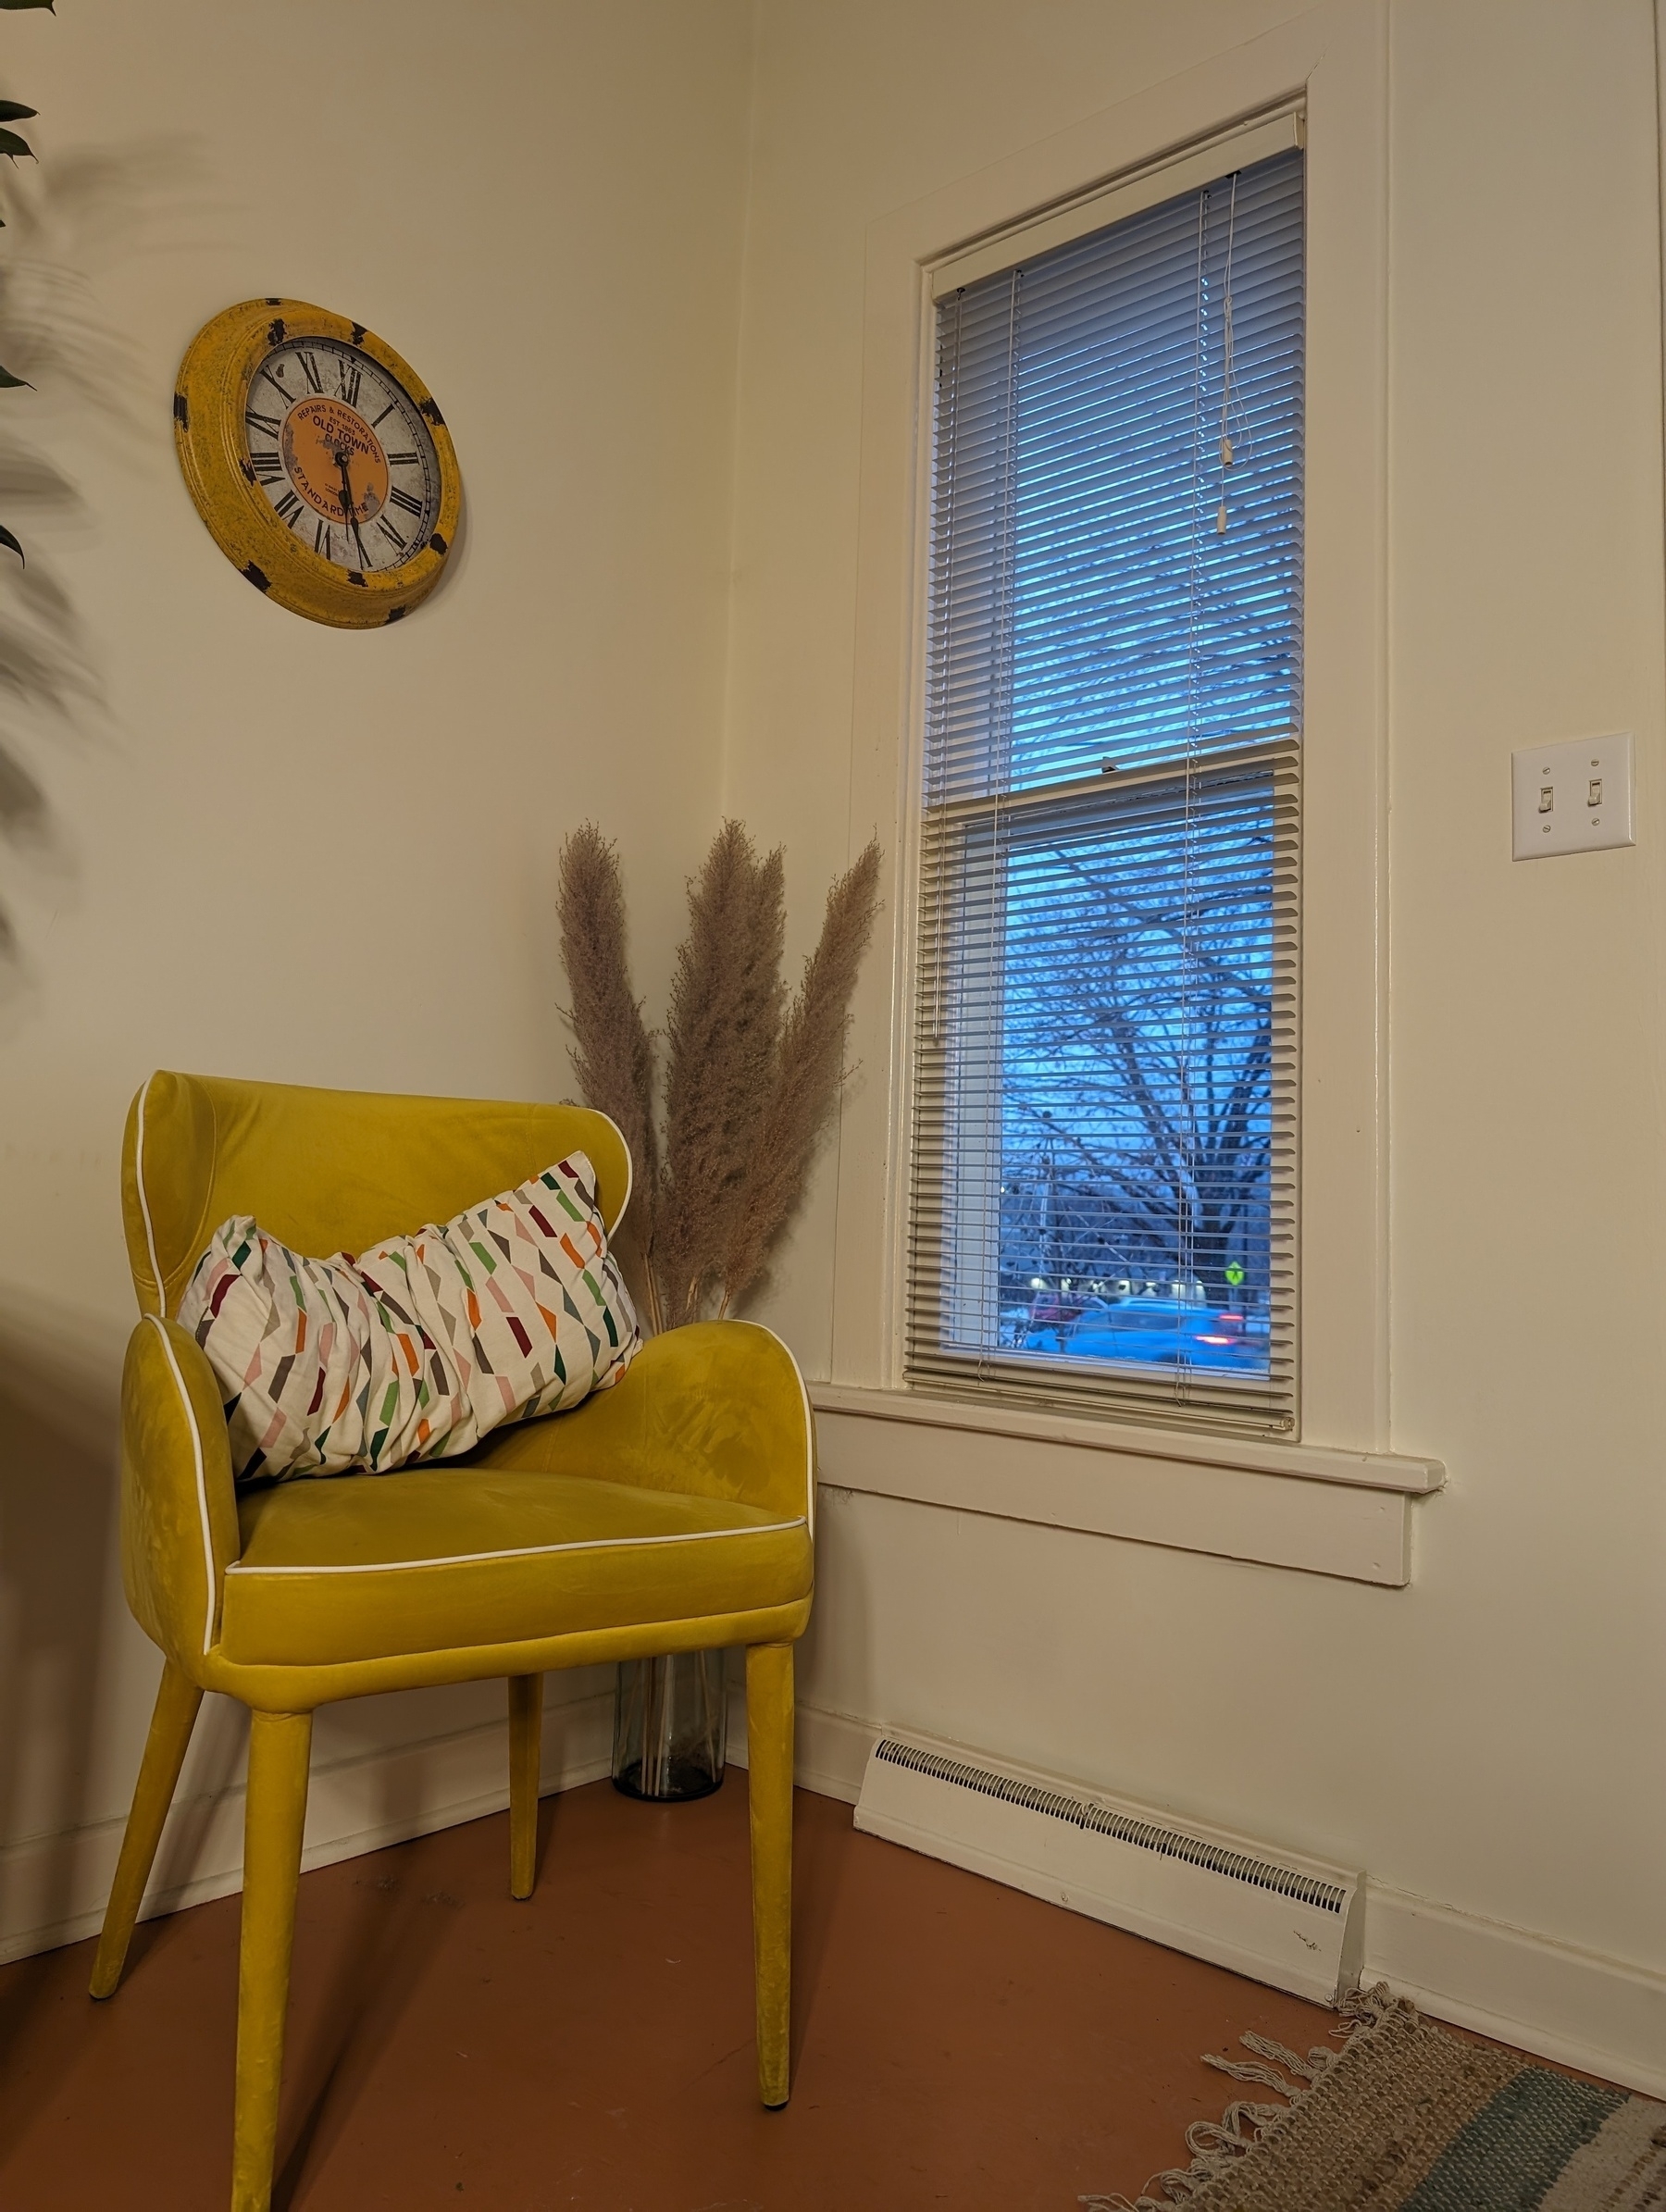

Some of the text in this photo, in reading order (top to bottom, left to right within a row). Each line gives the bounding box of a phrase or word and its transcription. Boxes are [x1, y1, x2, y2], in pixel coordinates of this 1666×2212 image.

[259, 365, 296, 409] X
[295, 352, 324, 394] XI
[333, 358, 363, 408] XII
[297, 404, 381, 464] REPAIRS & RESTORATIONS
[313, 415, 369, 454] OLD TOWN
[329, 416, 340, 426] EST
[371, 404, 395, 429] I
[325, 433, 354, 455] CLOCKS
[387, 452, 419, 466] II
[250, 452, 286, 487] VIII
[274, 489, 305, 529] VII
[294, 466, 344, 516] STANDARD
[390, 485, 422, 518] III
[315, 518, 331, 561] VI
